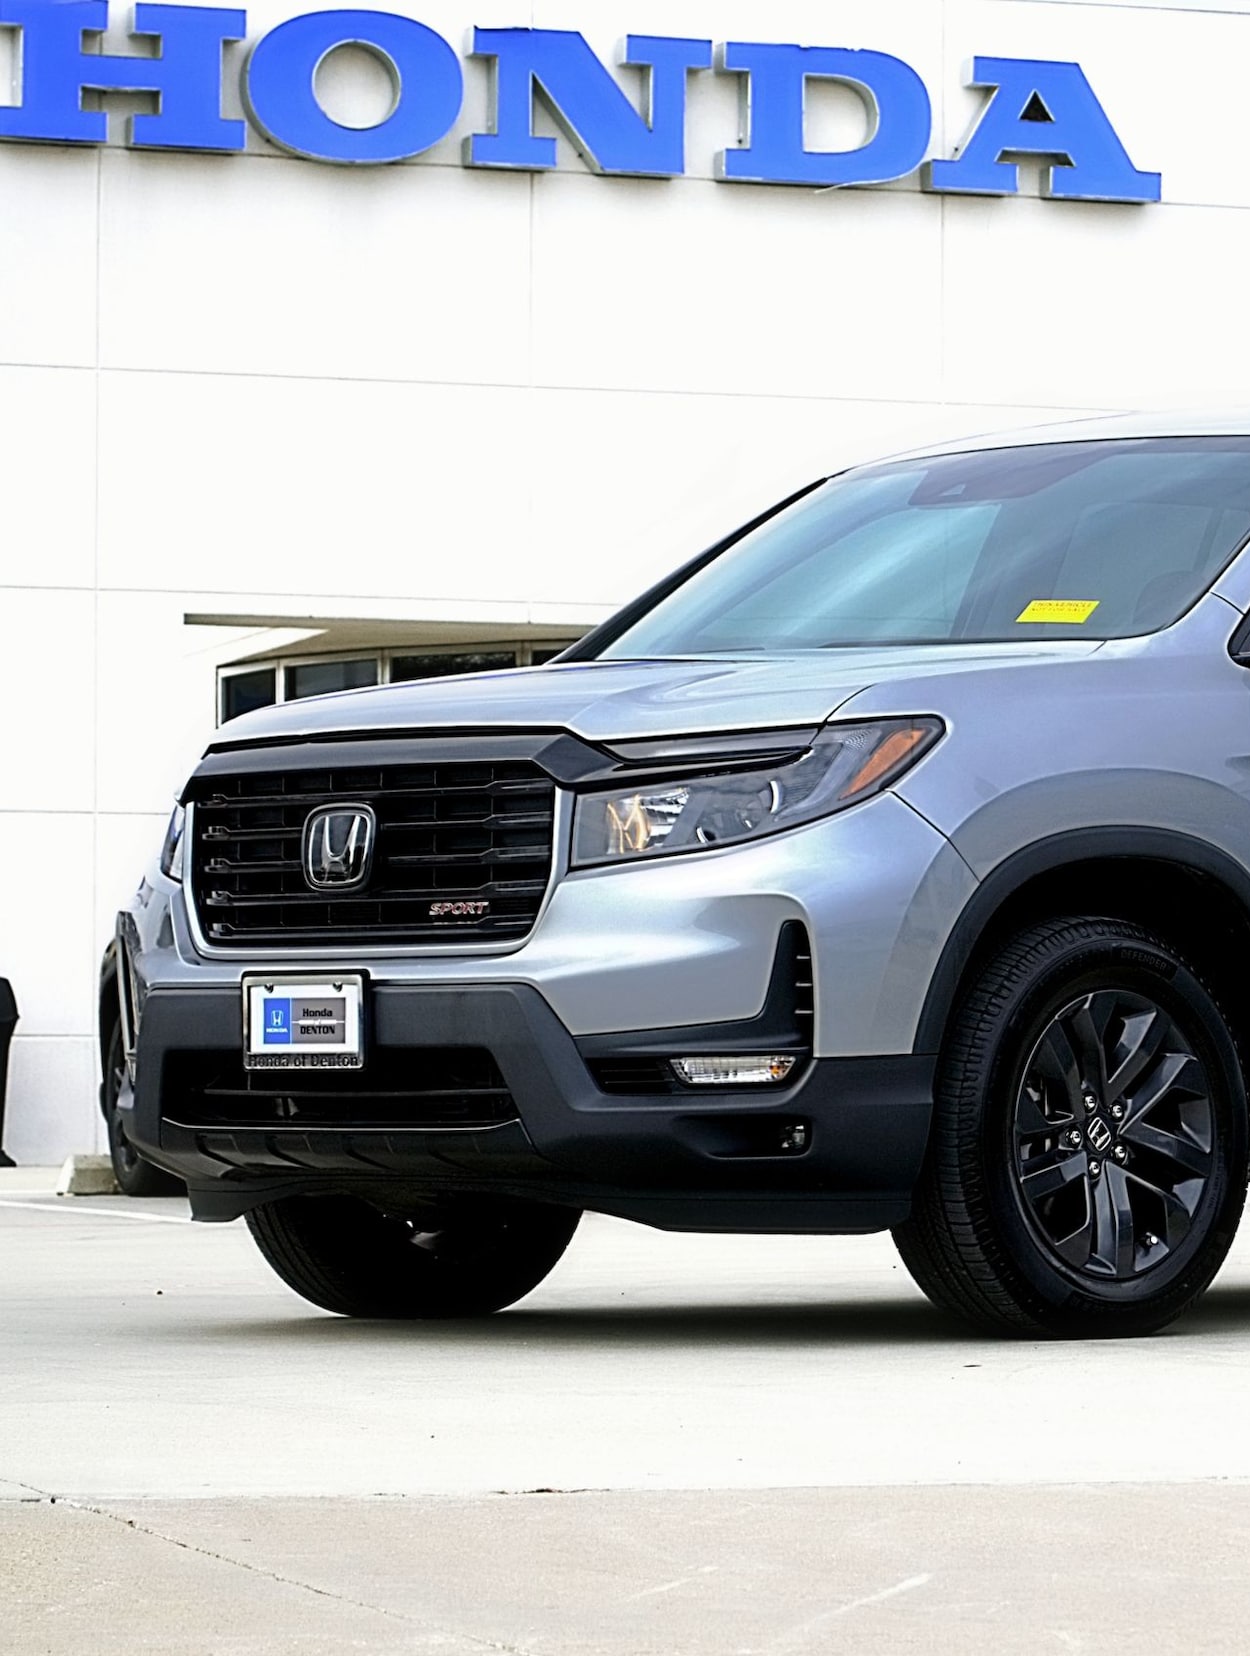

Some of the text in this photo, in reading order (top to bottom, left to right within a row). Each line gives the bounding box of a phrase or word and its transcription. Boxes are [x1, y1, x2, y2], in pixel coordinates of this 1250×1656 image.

[0, 0, 1162, 203] HONDA
[428, 901, 489, 916] SPORT
[302, 1008, 333, 1017] Honda
[300, 1025, 335, 1035] DENTON
[248, 1055, 358, 1067] Honda of Denton
